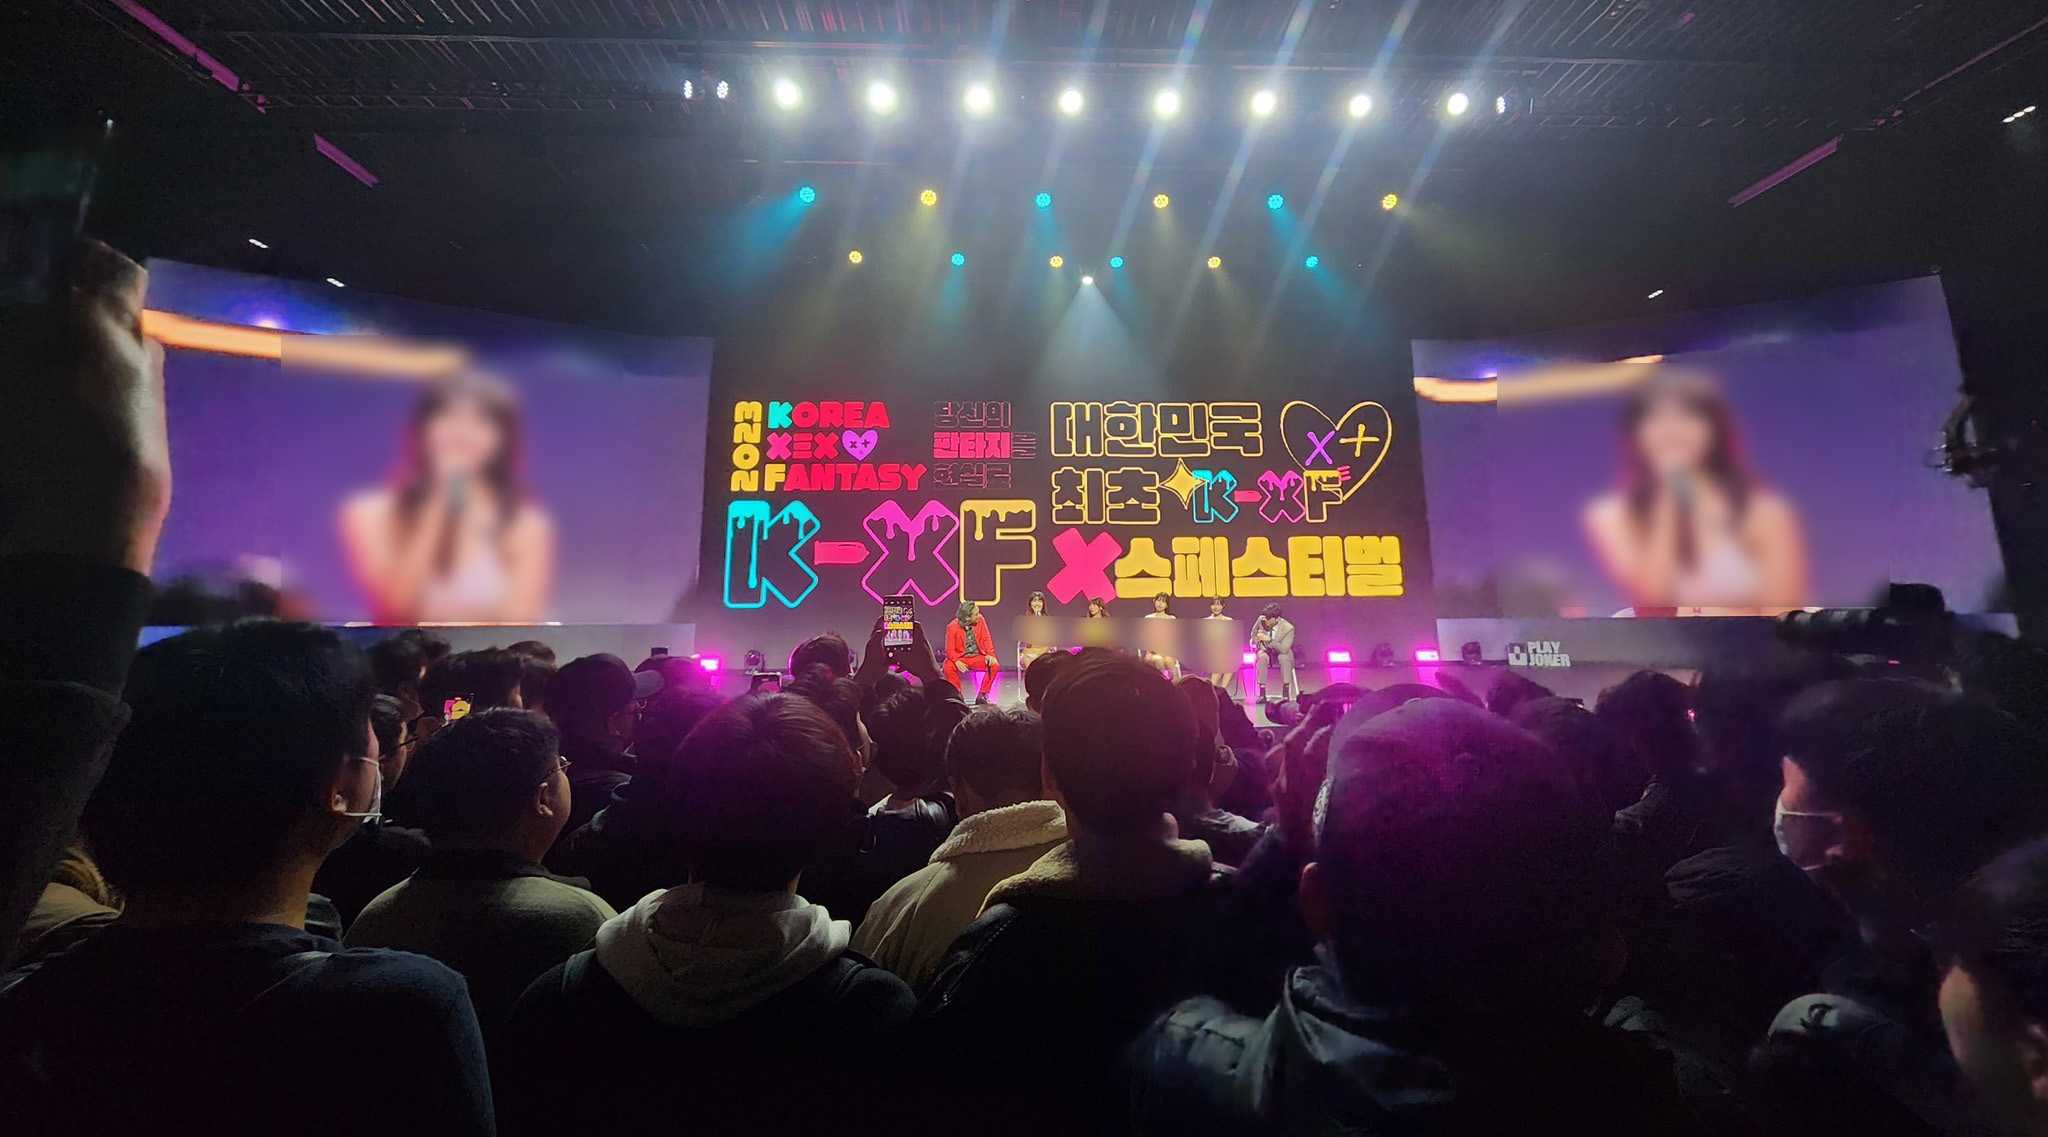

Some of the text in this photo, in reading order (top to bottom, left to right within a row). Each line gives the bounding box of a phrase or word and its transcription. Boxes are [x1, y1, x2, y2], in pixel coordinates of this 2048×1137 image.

[768, 401, 890, 428] KOREA
[933, 401, 1011, 428] 당신의
[1051, 401, 1263, 457] 대한민국
[730, 401, 762, 491] 2023
[933, 431, 1036, 459] 판타지를
[764, 463, 927, 491] FANTASY
[1052, 467, 1343, 525] 최초 K-XF
[723, 499, 1036, 608] K-XF
[1527, 641, 1561, 654] PLAY
[1529, 653, 1571, 667] JOKER
